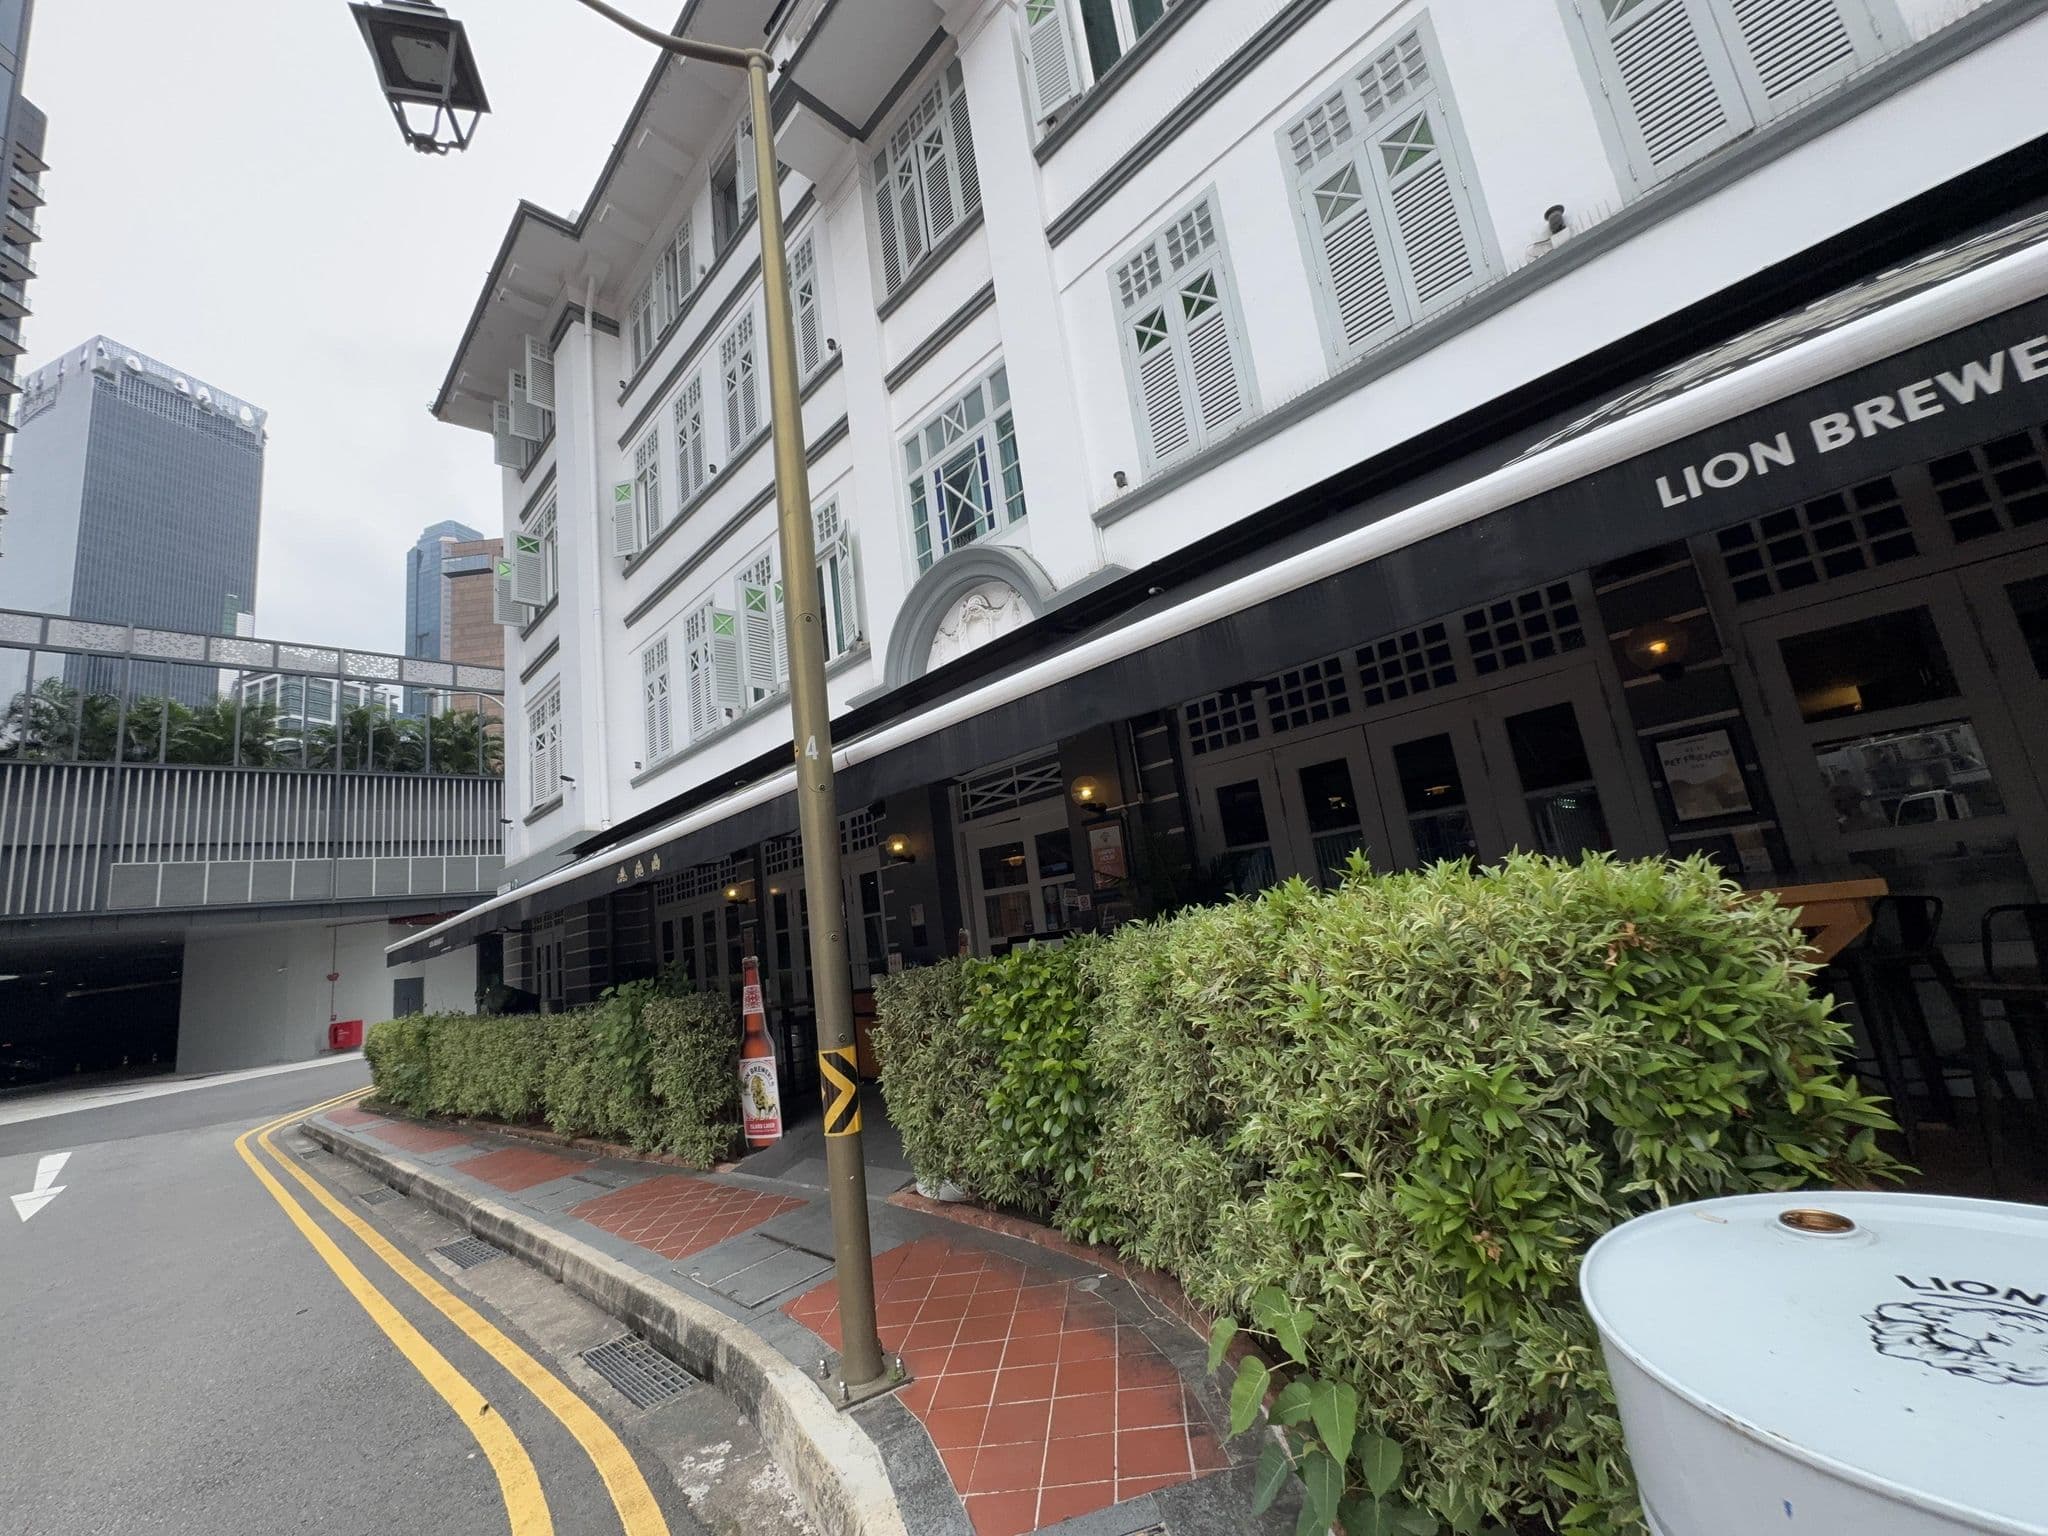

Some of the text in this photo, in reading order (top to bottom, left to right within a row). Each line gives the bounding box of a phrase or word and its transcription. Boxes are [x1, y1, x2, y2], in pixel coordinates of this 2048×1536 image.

[1656, 334, 2048, 509] LION BREWE
[805, 735, 819, 760] 4
[1894, 1274, 2048, 1306] LION
